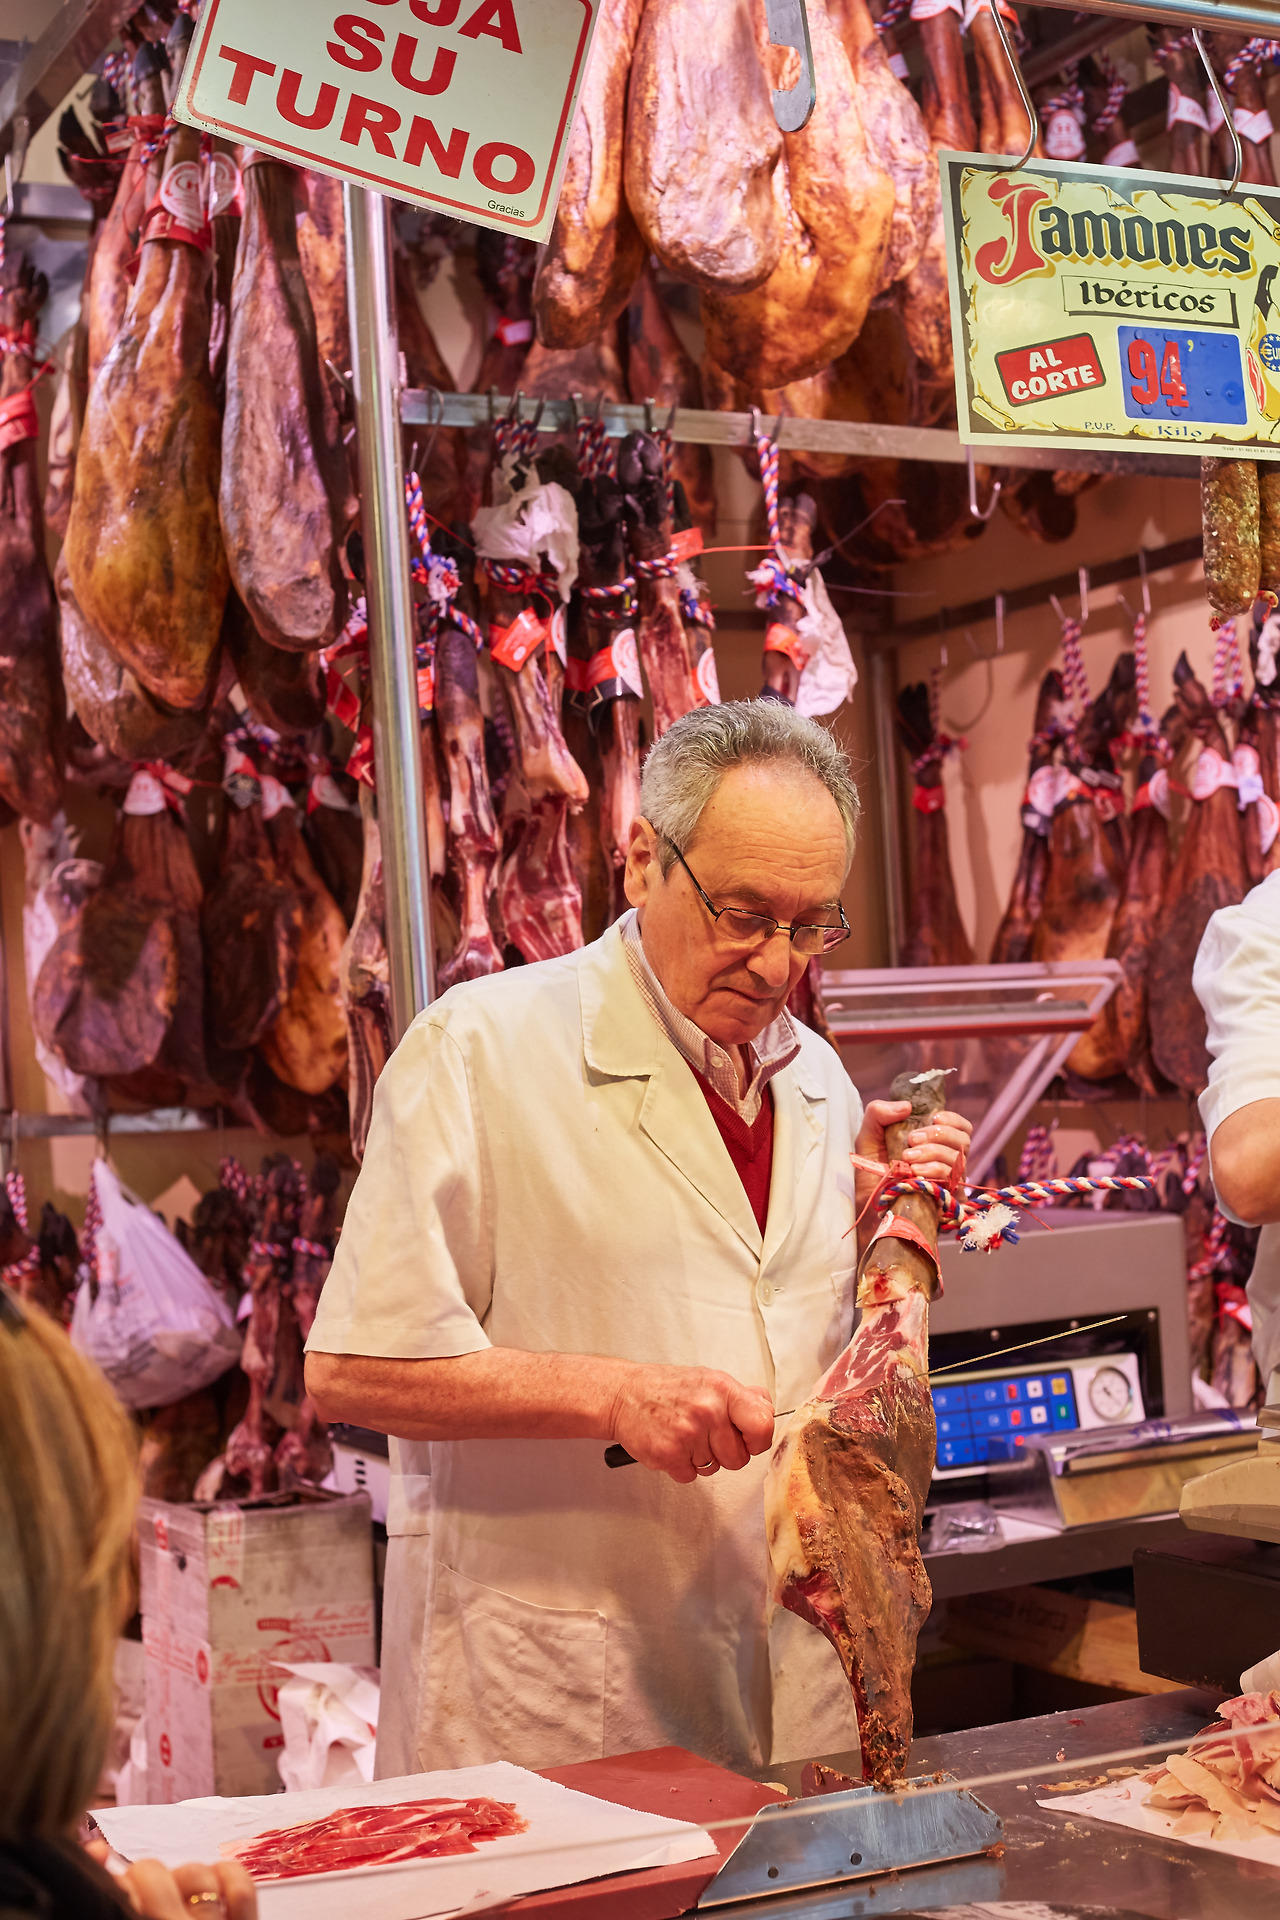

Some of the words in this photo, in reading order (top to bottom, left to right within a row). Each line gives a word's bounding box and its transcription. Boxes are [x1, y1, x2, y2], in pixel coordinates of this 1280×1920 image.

[326, 14, 458, 96] SU
[218, 44, 536, 195] TURNO
[486, 199, 526, 219] Gracias
[974, 177, 1254, 285] Jamones
[1080, 280, 1216, 314] Ibéricos
[1028, 348, 1063, 373] AL
[1011, 364, 1097, 401] CORTE
[1084, 421, 1116, 431] P.V.P.
[1157, 425, 1202, 437] Kilo
